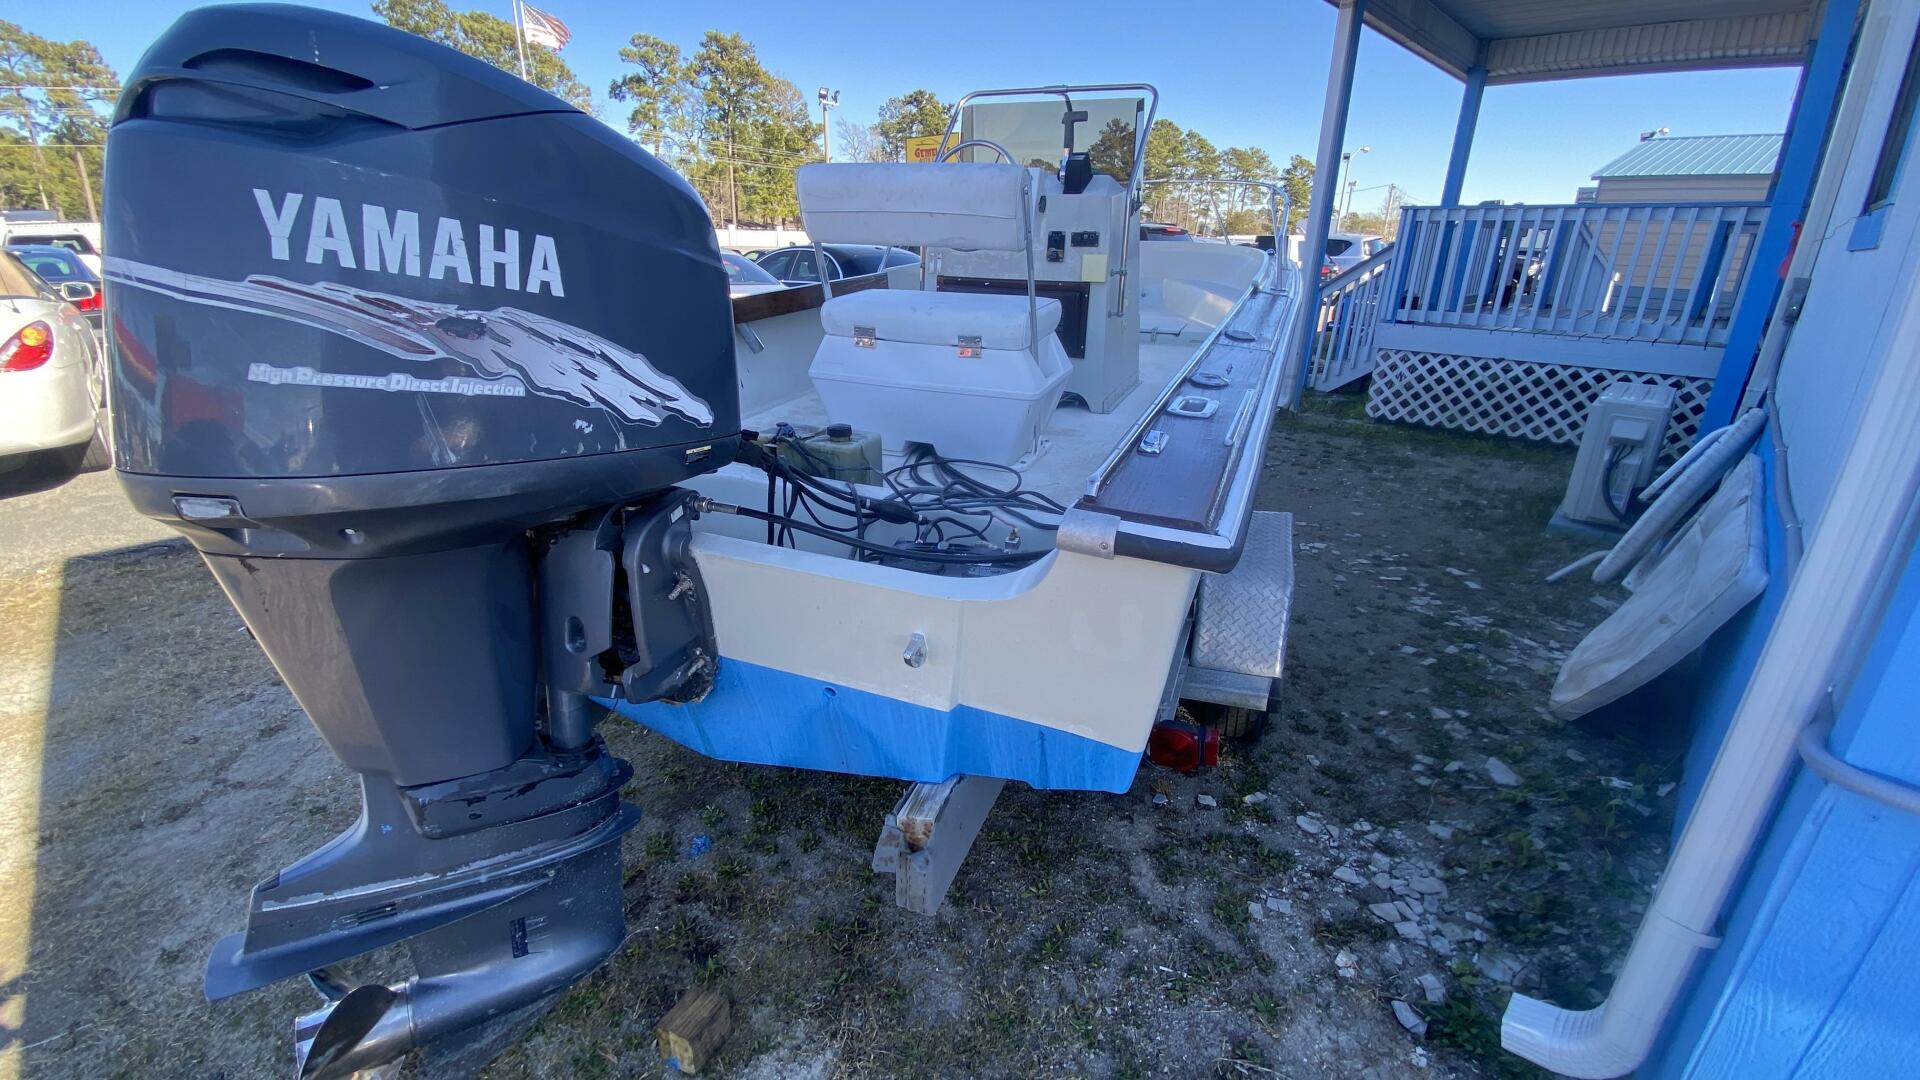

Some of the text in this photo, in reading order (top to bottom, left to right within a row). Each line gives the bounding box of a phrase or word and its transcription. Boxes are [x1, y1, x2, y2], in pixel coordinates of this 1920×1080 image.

[253, 188, 564, 297] YAMAHA
[249, 364, 525, 396] High Pressure Direct Injection
